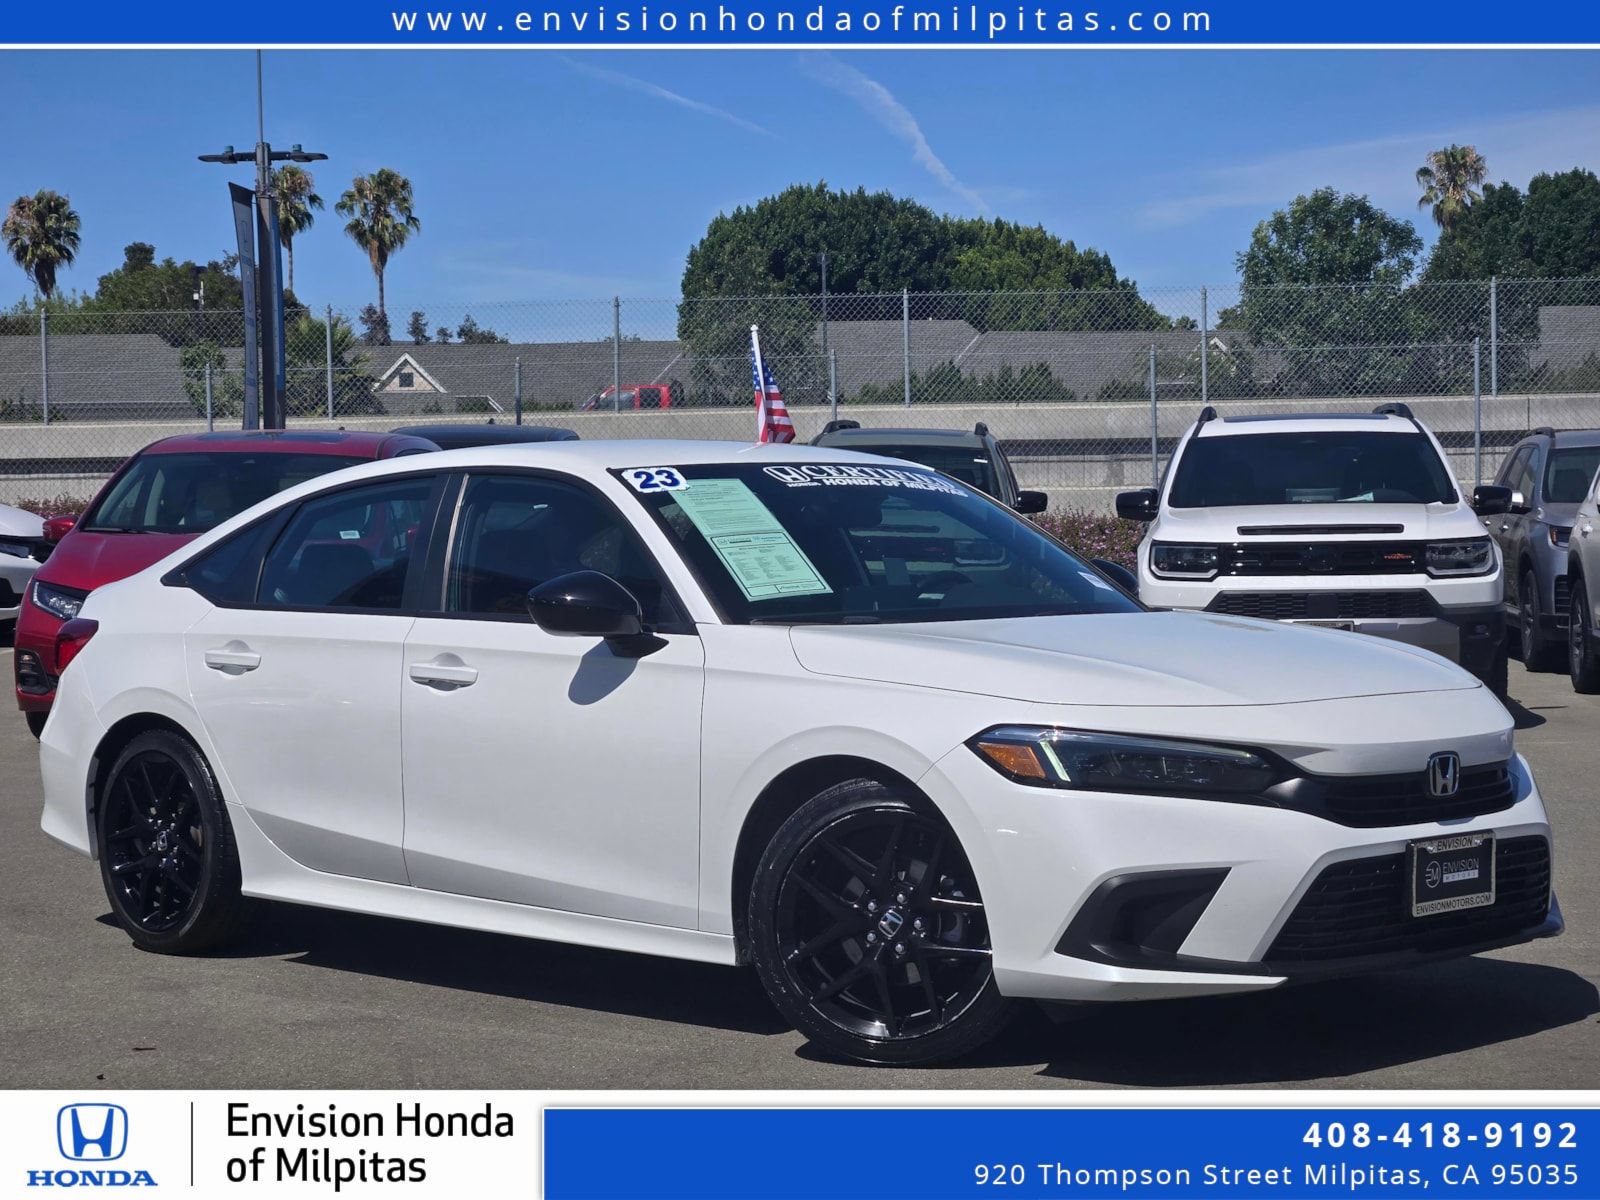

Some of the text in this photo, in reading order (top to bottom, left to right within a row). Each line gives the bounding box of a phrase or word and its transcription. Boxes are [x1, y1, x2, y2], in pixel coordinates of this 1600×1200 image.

[633, 469, 681, 489] 23
[800, 465, 955, 489] CERTIFIED
[822, 478, 881, 487] HONDA
[880, 479, 901, 488] OF
[1437, 836, 1473, 851] ENVISION
[1442, 858, 1479, 874] ENVISION
[1416, 895, 1492, 915] ENVISIONMOTORS.COM
